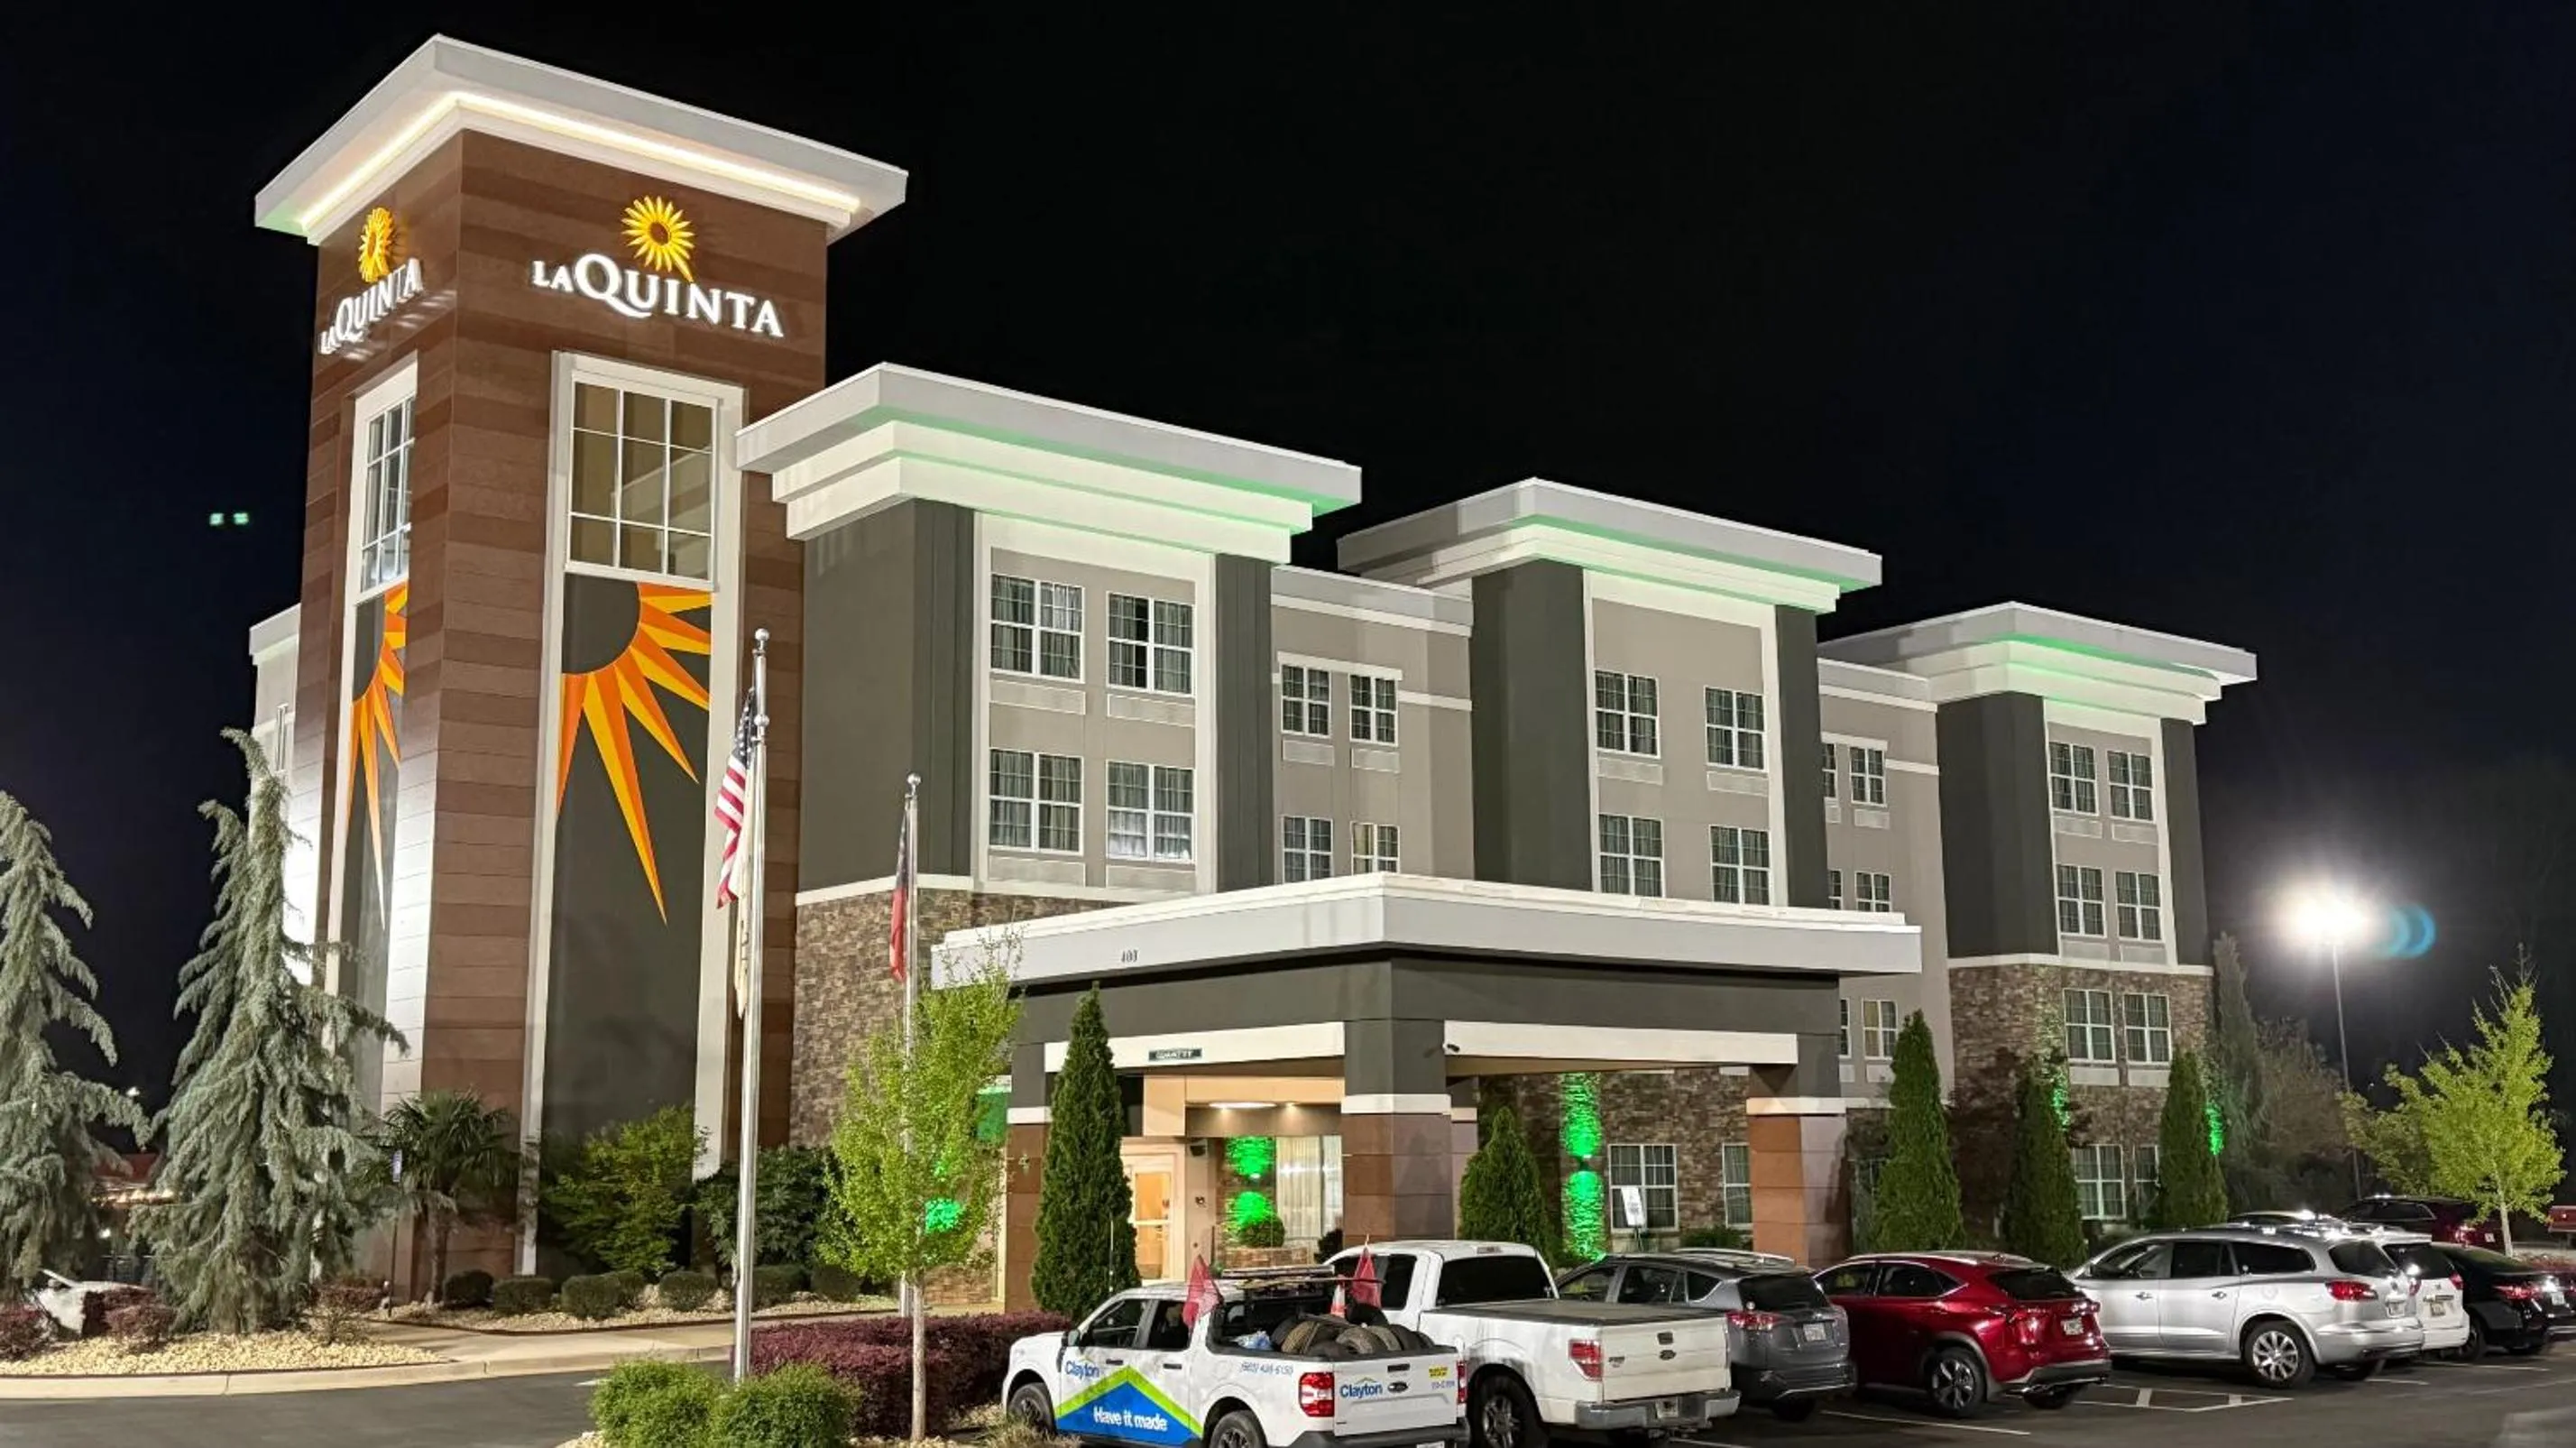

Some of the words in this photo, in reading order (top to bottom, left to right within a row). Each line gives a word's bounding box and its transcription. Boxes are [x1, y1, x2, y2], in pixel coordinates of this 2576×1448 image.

[336, 257, 424, 344] QUINTA
[532, 260, 575, 292] LA
[575, 254, 784, 337] QUINTA
[1065, 1360, 1100, 1380] Clayton
[1339, 1382, 1384, 1398] Clayton
[1093, 1406, 1122, 1425] Have
[1123, 1409, 1133, 1428] it
[1134, 1413, 1169, 1433] made
